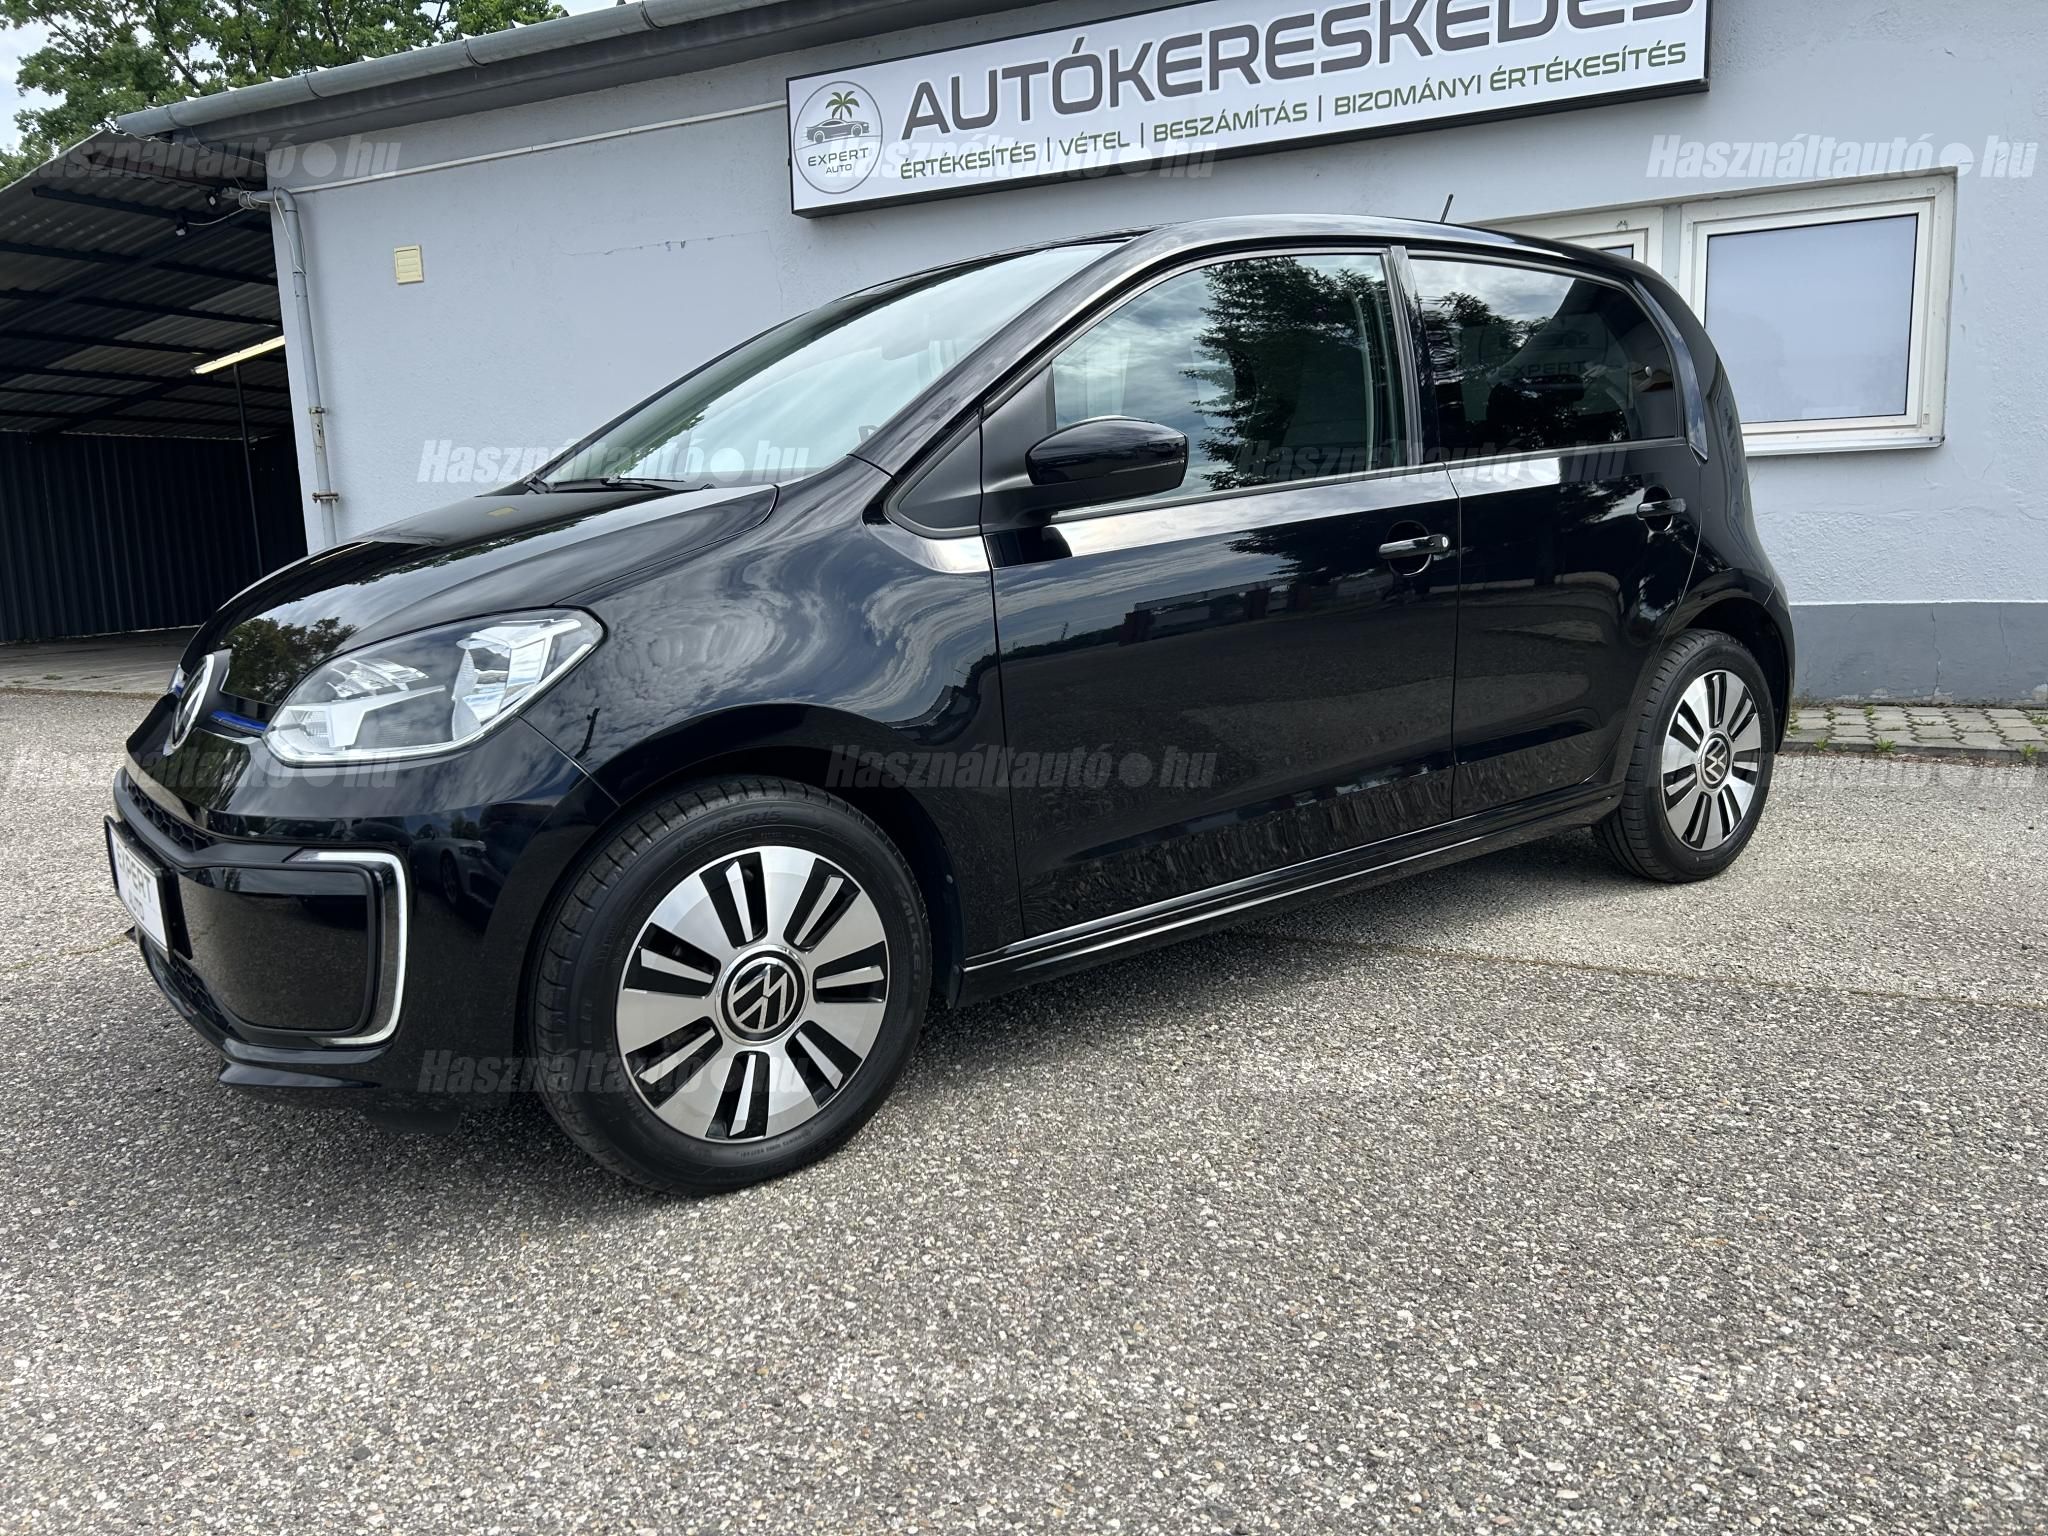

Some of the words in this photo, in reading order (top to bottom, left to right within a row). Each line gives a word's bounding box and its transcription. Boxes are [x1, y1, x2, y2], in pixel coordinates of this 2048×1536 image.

[900, 142, 1037, 181] ÉRTÉKESÍTÉS
[1059, 130, 1131, 156] VÉTEL
[1153, 99, 1308, 143] BESZÁMÍTÁS
[1334, 73, 1481, 116] BIZOMÁNYI
[1489, 39, 1687, 92] ÉRTÉKESÍTÉS
[901, 0, 1696, 140] AUTÓKERESKED
[807, 147, 869, 167] EXPERT
[825, 162, 853, 174] AUTO
